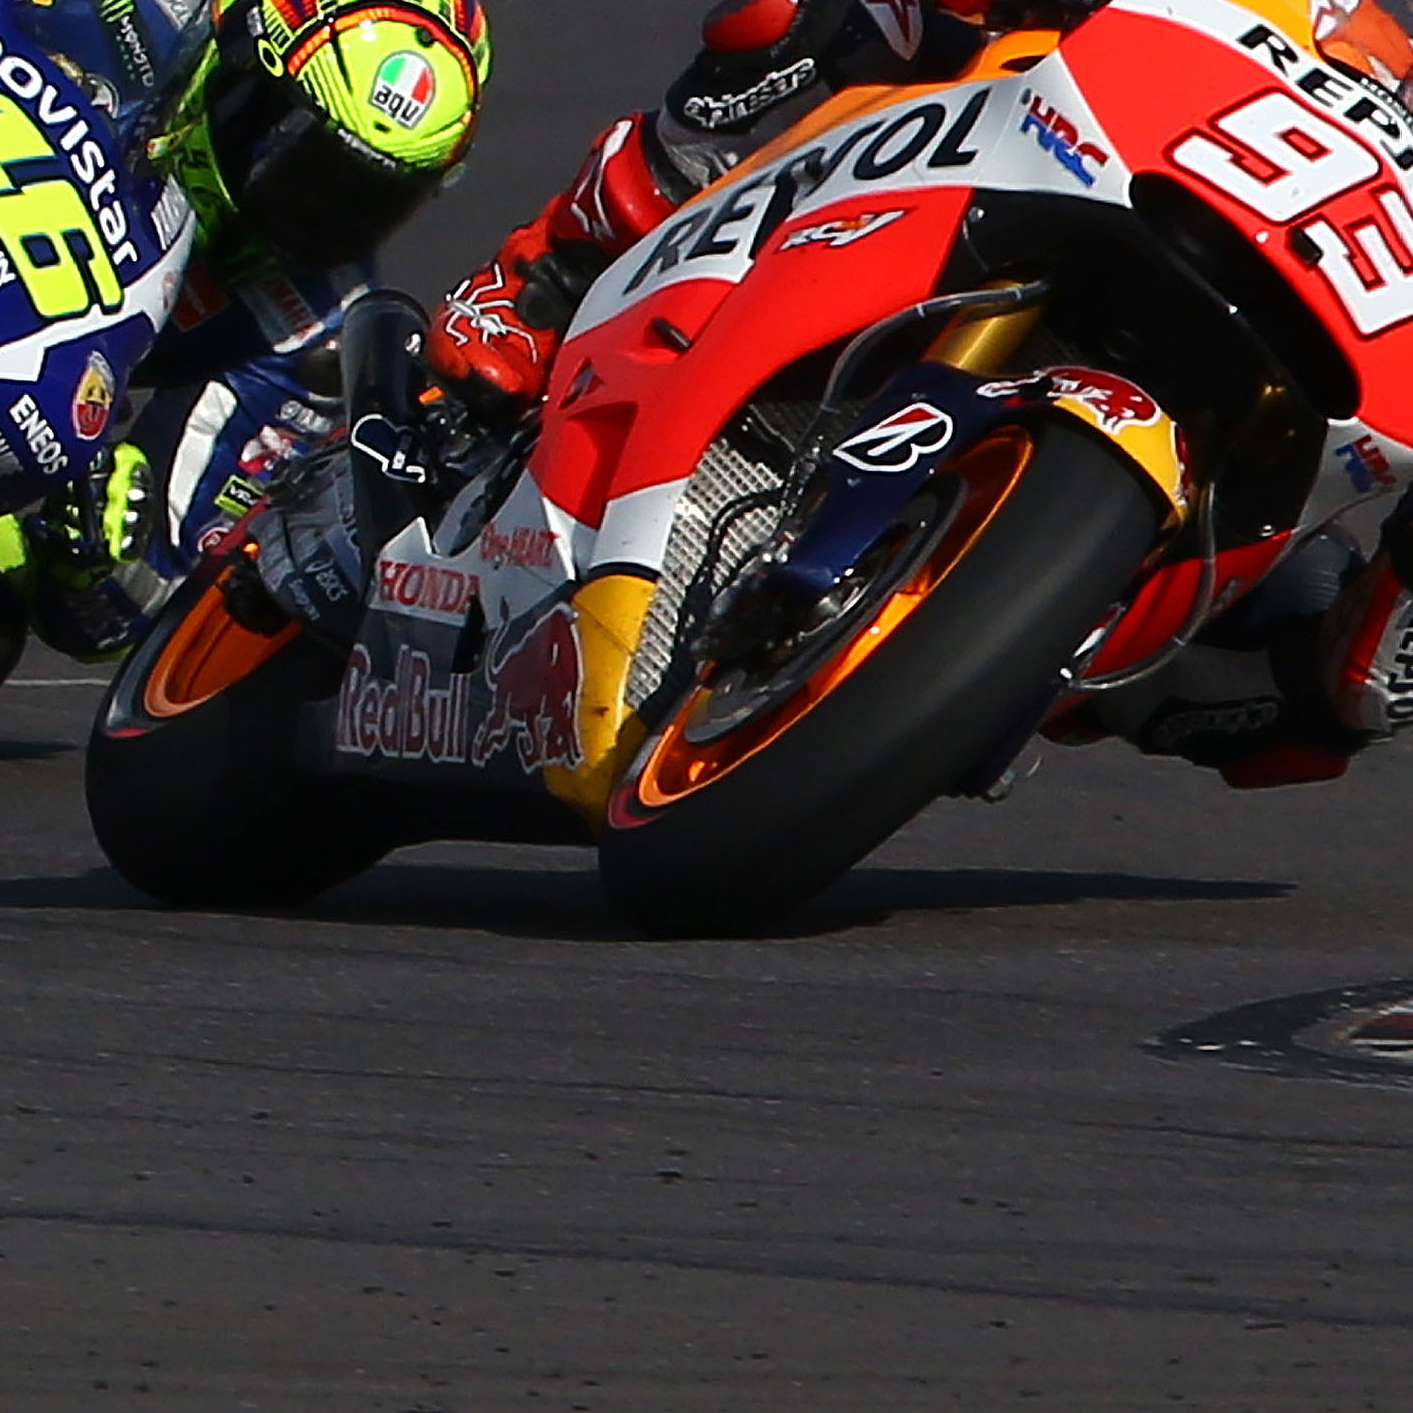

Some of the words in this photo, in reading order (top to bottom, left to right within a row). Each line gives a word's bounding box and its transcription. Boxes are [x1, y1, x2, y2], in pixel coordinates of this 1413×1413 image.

[1020, 95, 1108, 186] HRC
[1167, 90, 1413, 337] 93
[9, 393, 69, 475] ENEOS
[380, 561, 481, 615] HONDA
[336, 642, 408, 756] Red
[403, 650, 472, 763] Bull
